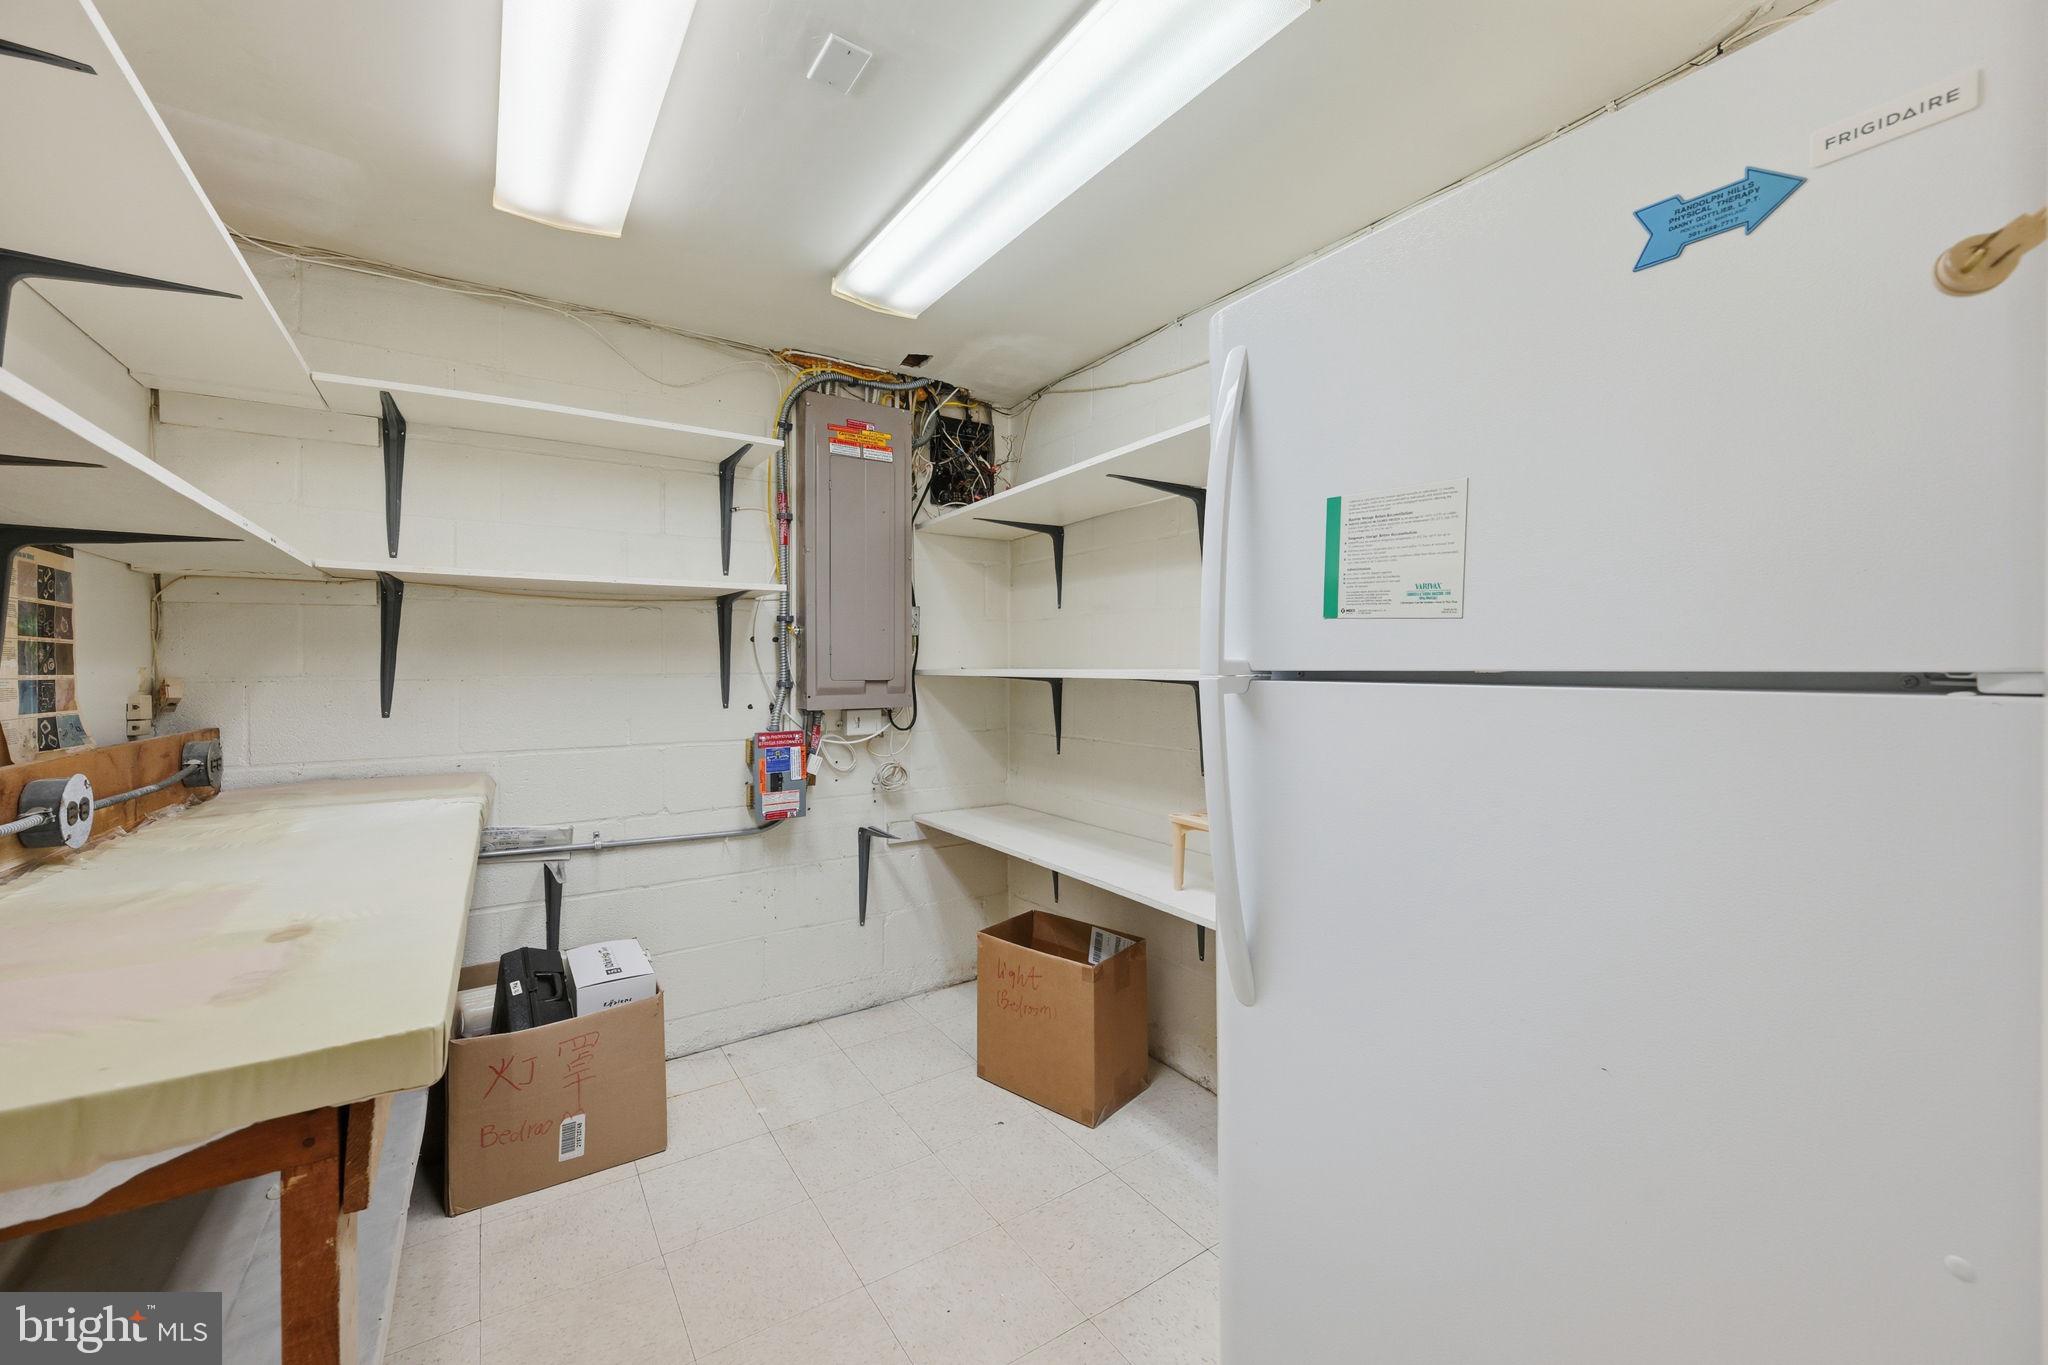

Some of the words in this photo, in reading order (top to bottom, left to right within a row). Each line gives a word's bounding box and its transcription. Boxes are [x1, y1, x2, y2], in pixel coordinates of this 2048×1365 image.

[1825, 87, 1960, 150] FRIGIDAIRE
[1668, 205, 1712, 224] PHYSICAL
[1717, 186, 1761, 207] THERAPY
[1674, 193, 1724, 215] RANDOLPH
[1727, 181, 1755, 196] HILLS
[1668, 220, 1693, 232] DANNY
[480, 1113, 576, 1148] Bedroo
